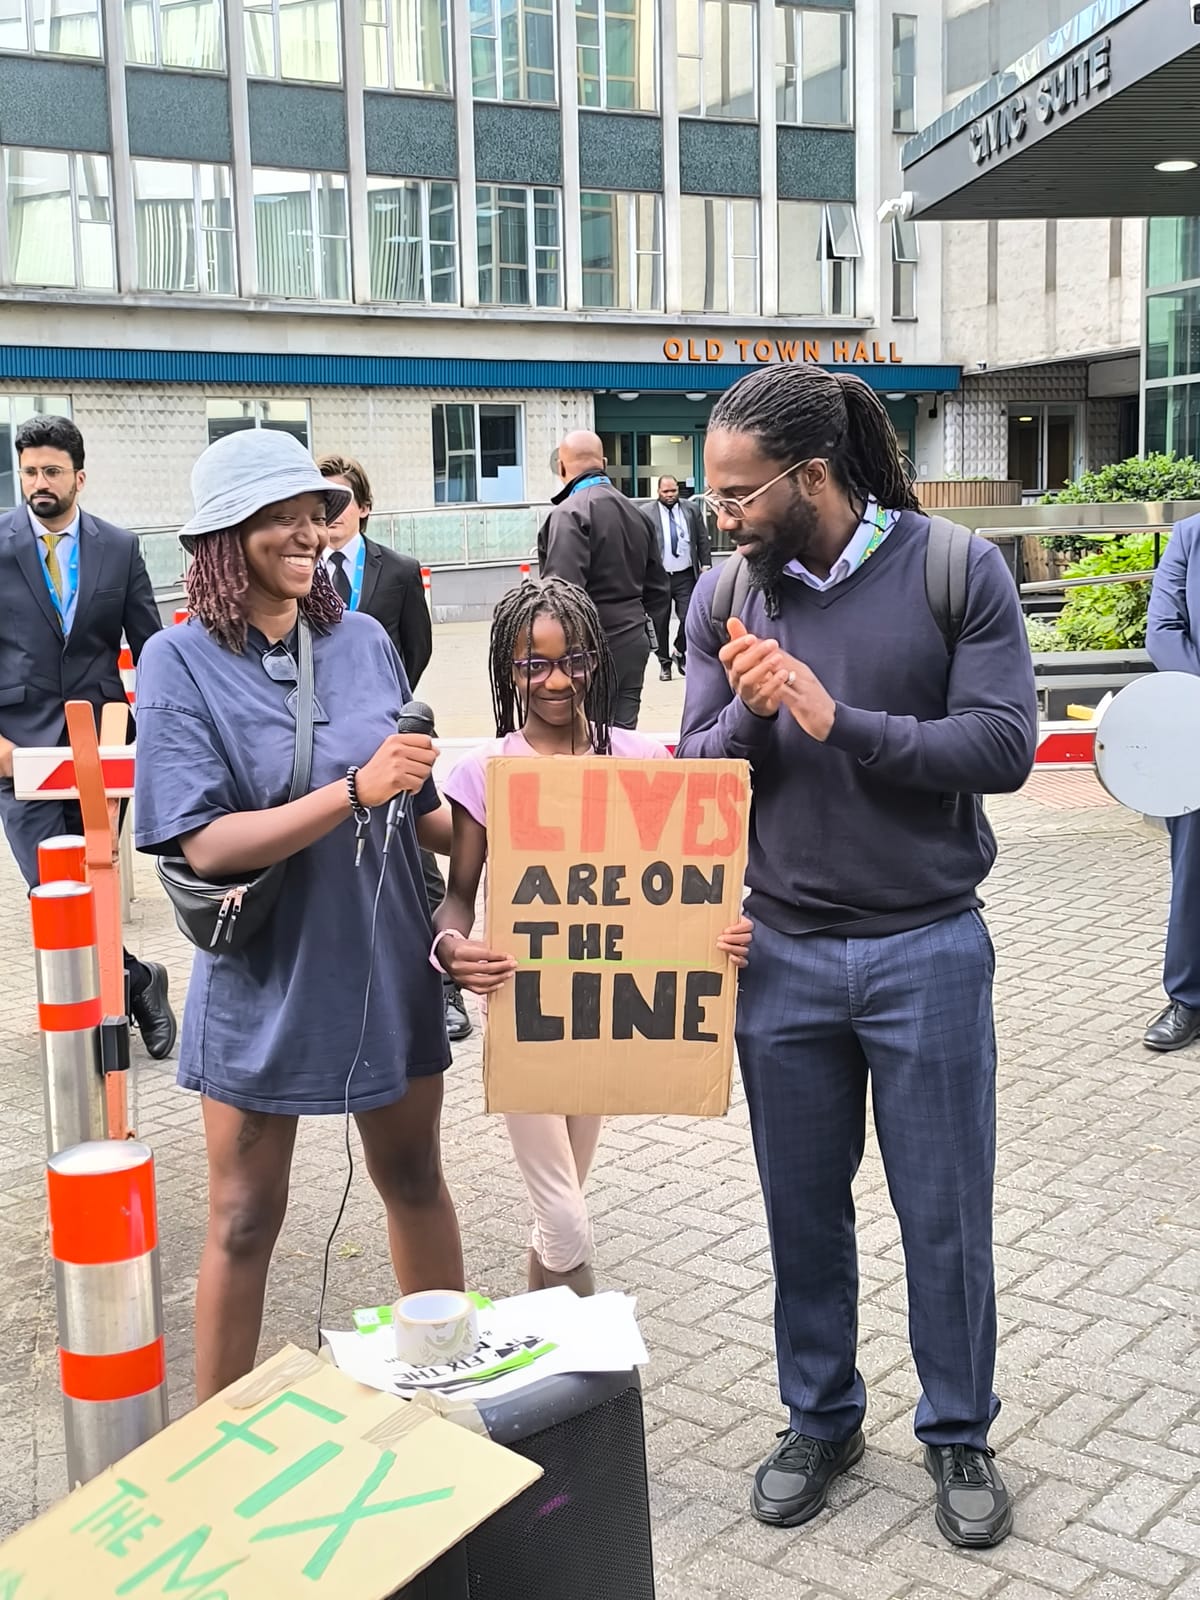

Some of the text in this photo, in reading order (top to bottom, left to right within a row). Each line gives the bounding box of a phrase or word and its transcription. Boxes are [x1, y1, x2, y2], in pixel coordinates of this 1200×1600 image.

[969, 36, 1112, 167] CIVIC SUITE
[663, 337, 903, 363] OLD TOWN HALL
[508, 769, 746, 857] LIVES
[511, 860, 725, 906] ARE ON
[513, 921, 624, 960] THE
[514, 970, 723, 1042] LINE
[71, 1478, 163, 1558] THE
[166, 1391, 456, 1581] FIX
